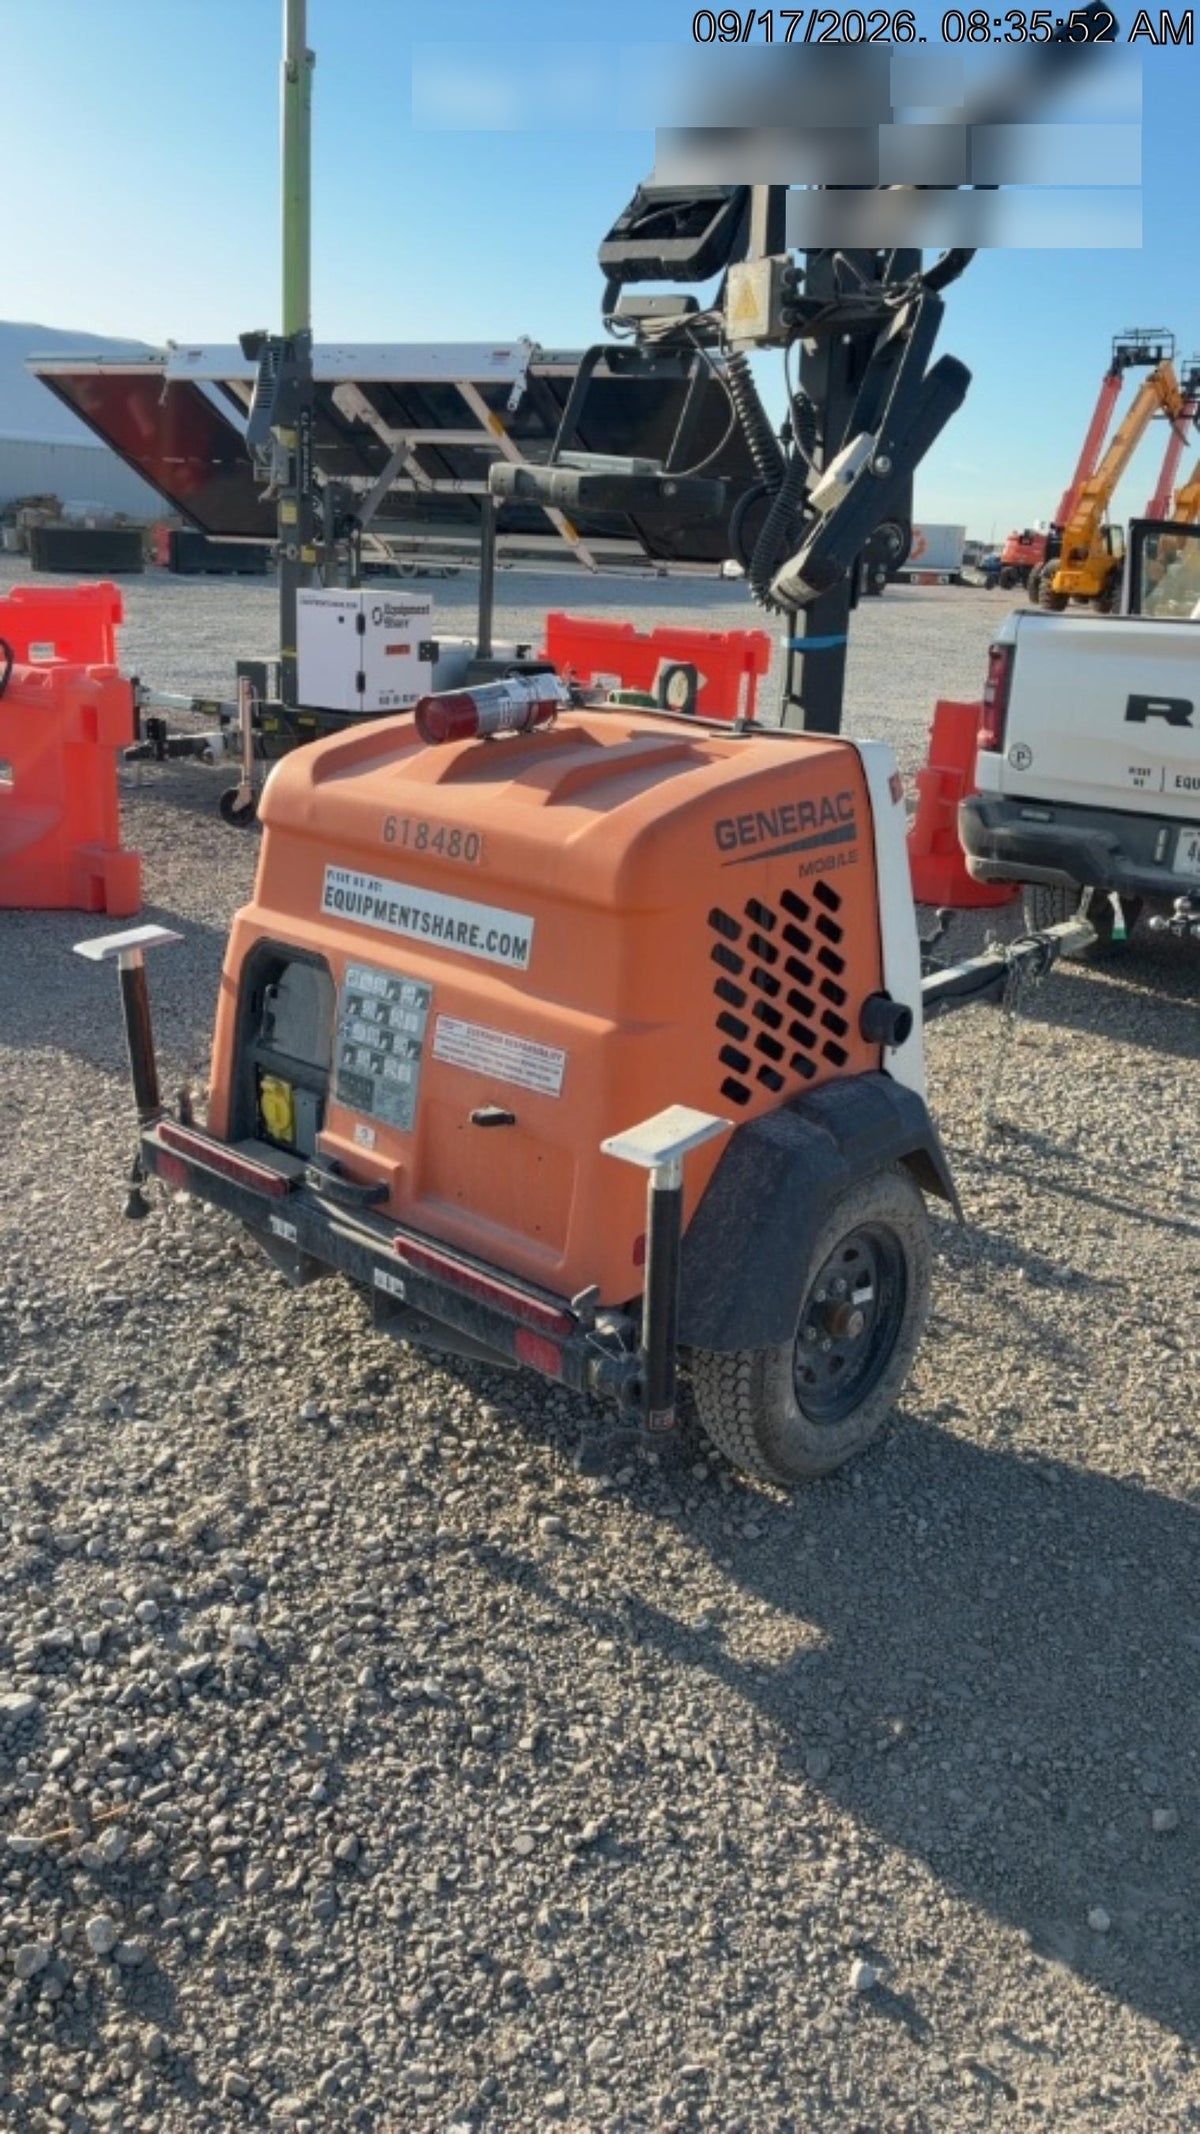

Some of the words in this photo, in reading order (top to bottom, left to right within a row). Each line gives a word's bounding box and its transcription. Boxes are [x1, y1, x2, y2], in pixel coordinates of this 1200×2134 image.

[1125, 694, 1193, 728] R
[383, 816, 480, 862] 618480
[715, 792, 855, 850] GENERAC
[799, 849, 859, 877] MOBILE
[324, 886, 528, 961] EQUIPMENTSHARE.COM
